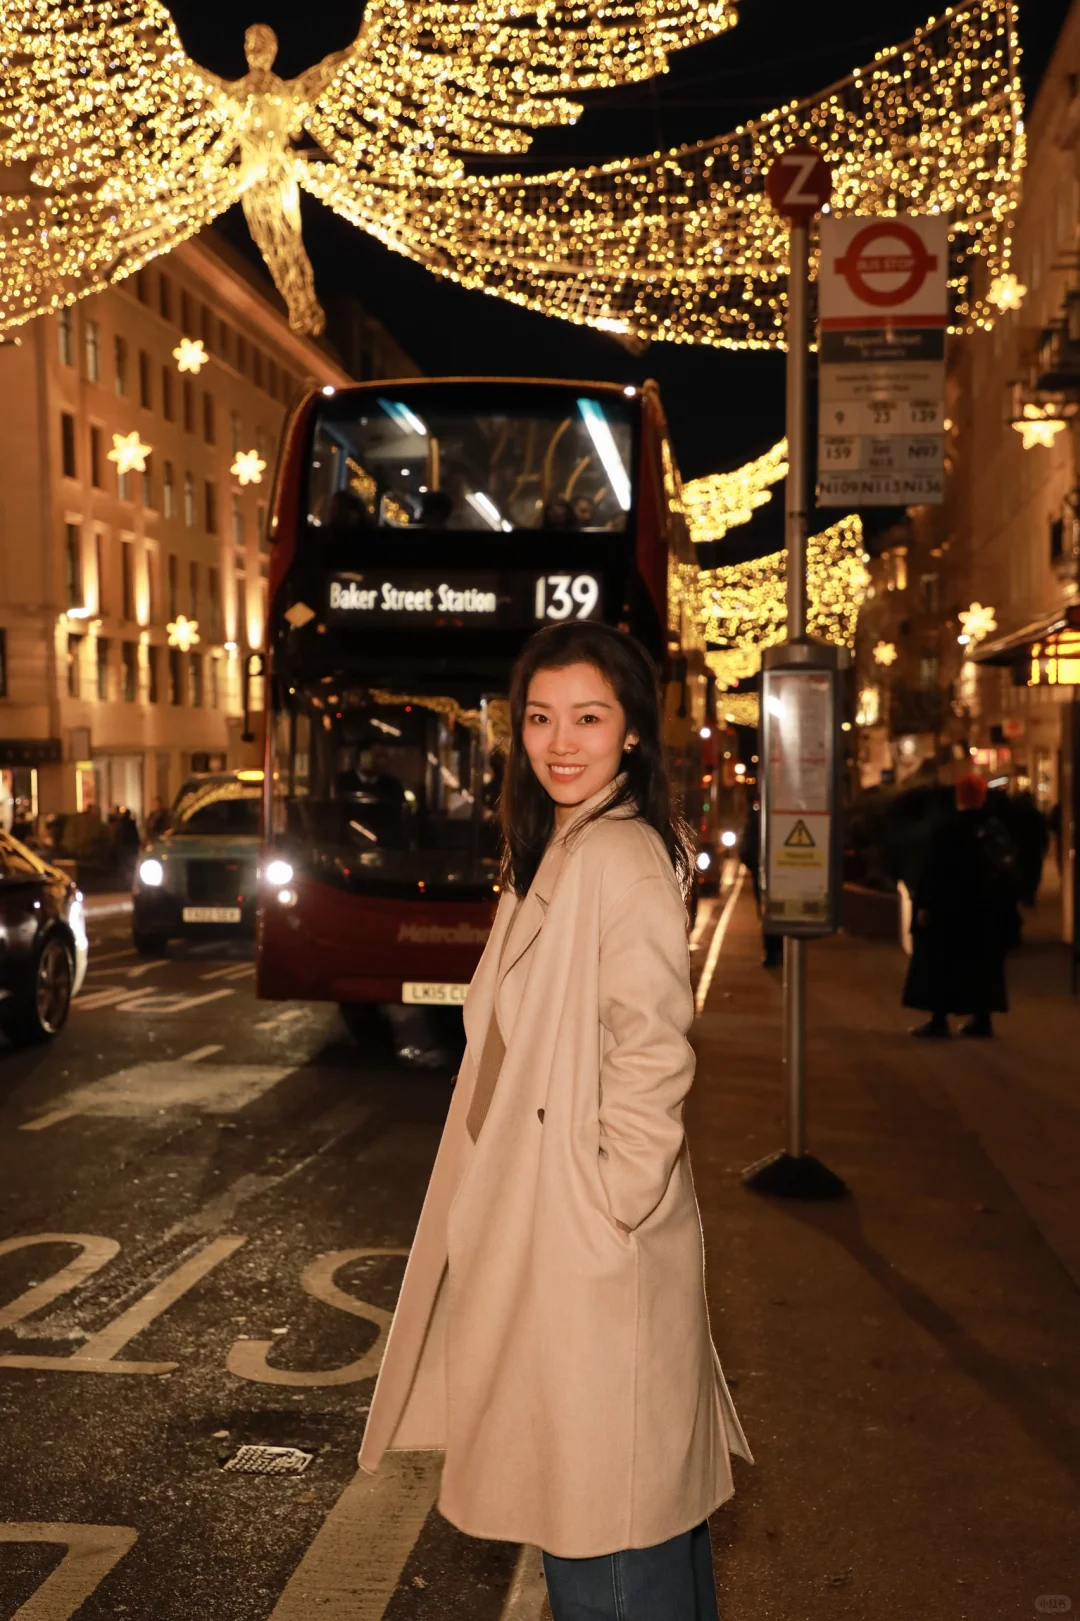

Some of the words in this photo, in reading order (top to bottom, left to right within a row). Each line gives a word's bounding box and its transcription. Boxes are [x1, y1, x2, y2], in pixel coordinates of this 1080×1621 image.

[780, 154, 820, 205] Z
[330, 582, 378, 610] Baker
[380, 582, 434, 611] Street
[437, 583, 497, 613] Station
[535, 574, 599, 620] 139
